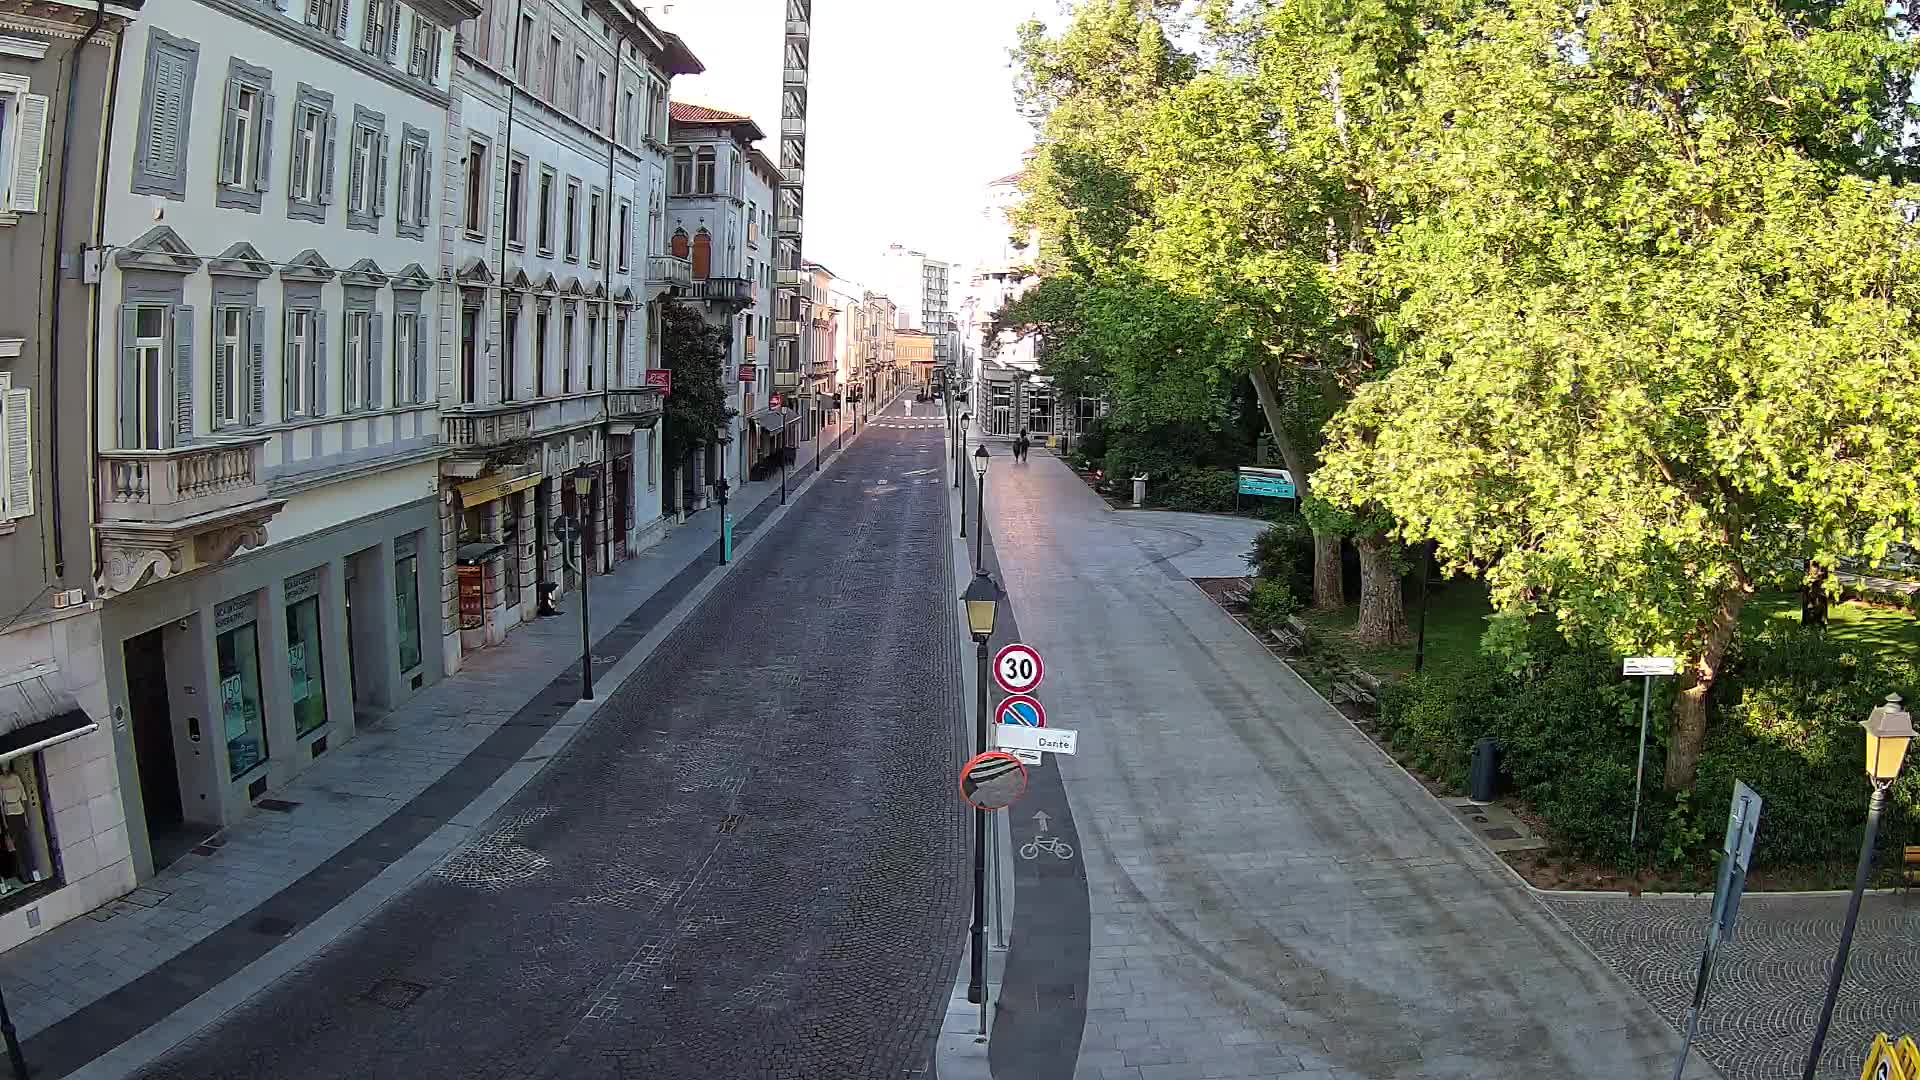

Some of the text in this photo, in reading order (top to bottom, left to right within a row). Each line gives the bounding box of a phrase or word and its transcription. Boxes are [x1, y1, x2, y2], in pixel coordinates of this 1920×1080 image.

[1005, 658, 1032, 679] 30
[223, 677, 241, 701] 130
[1039, 737, 1070, 748] Dante
